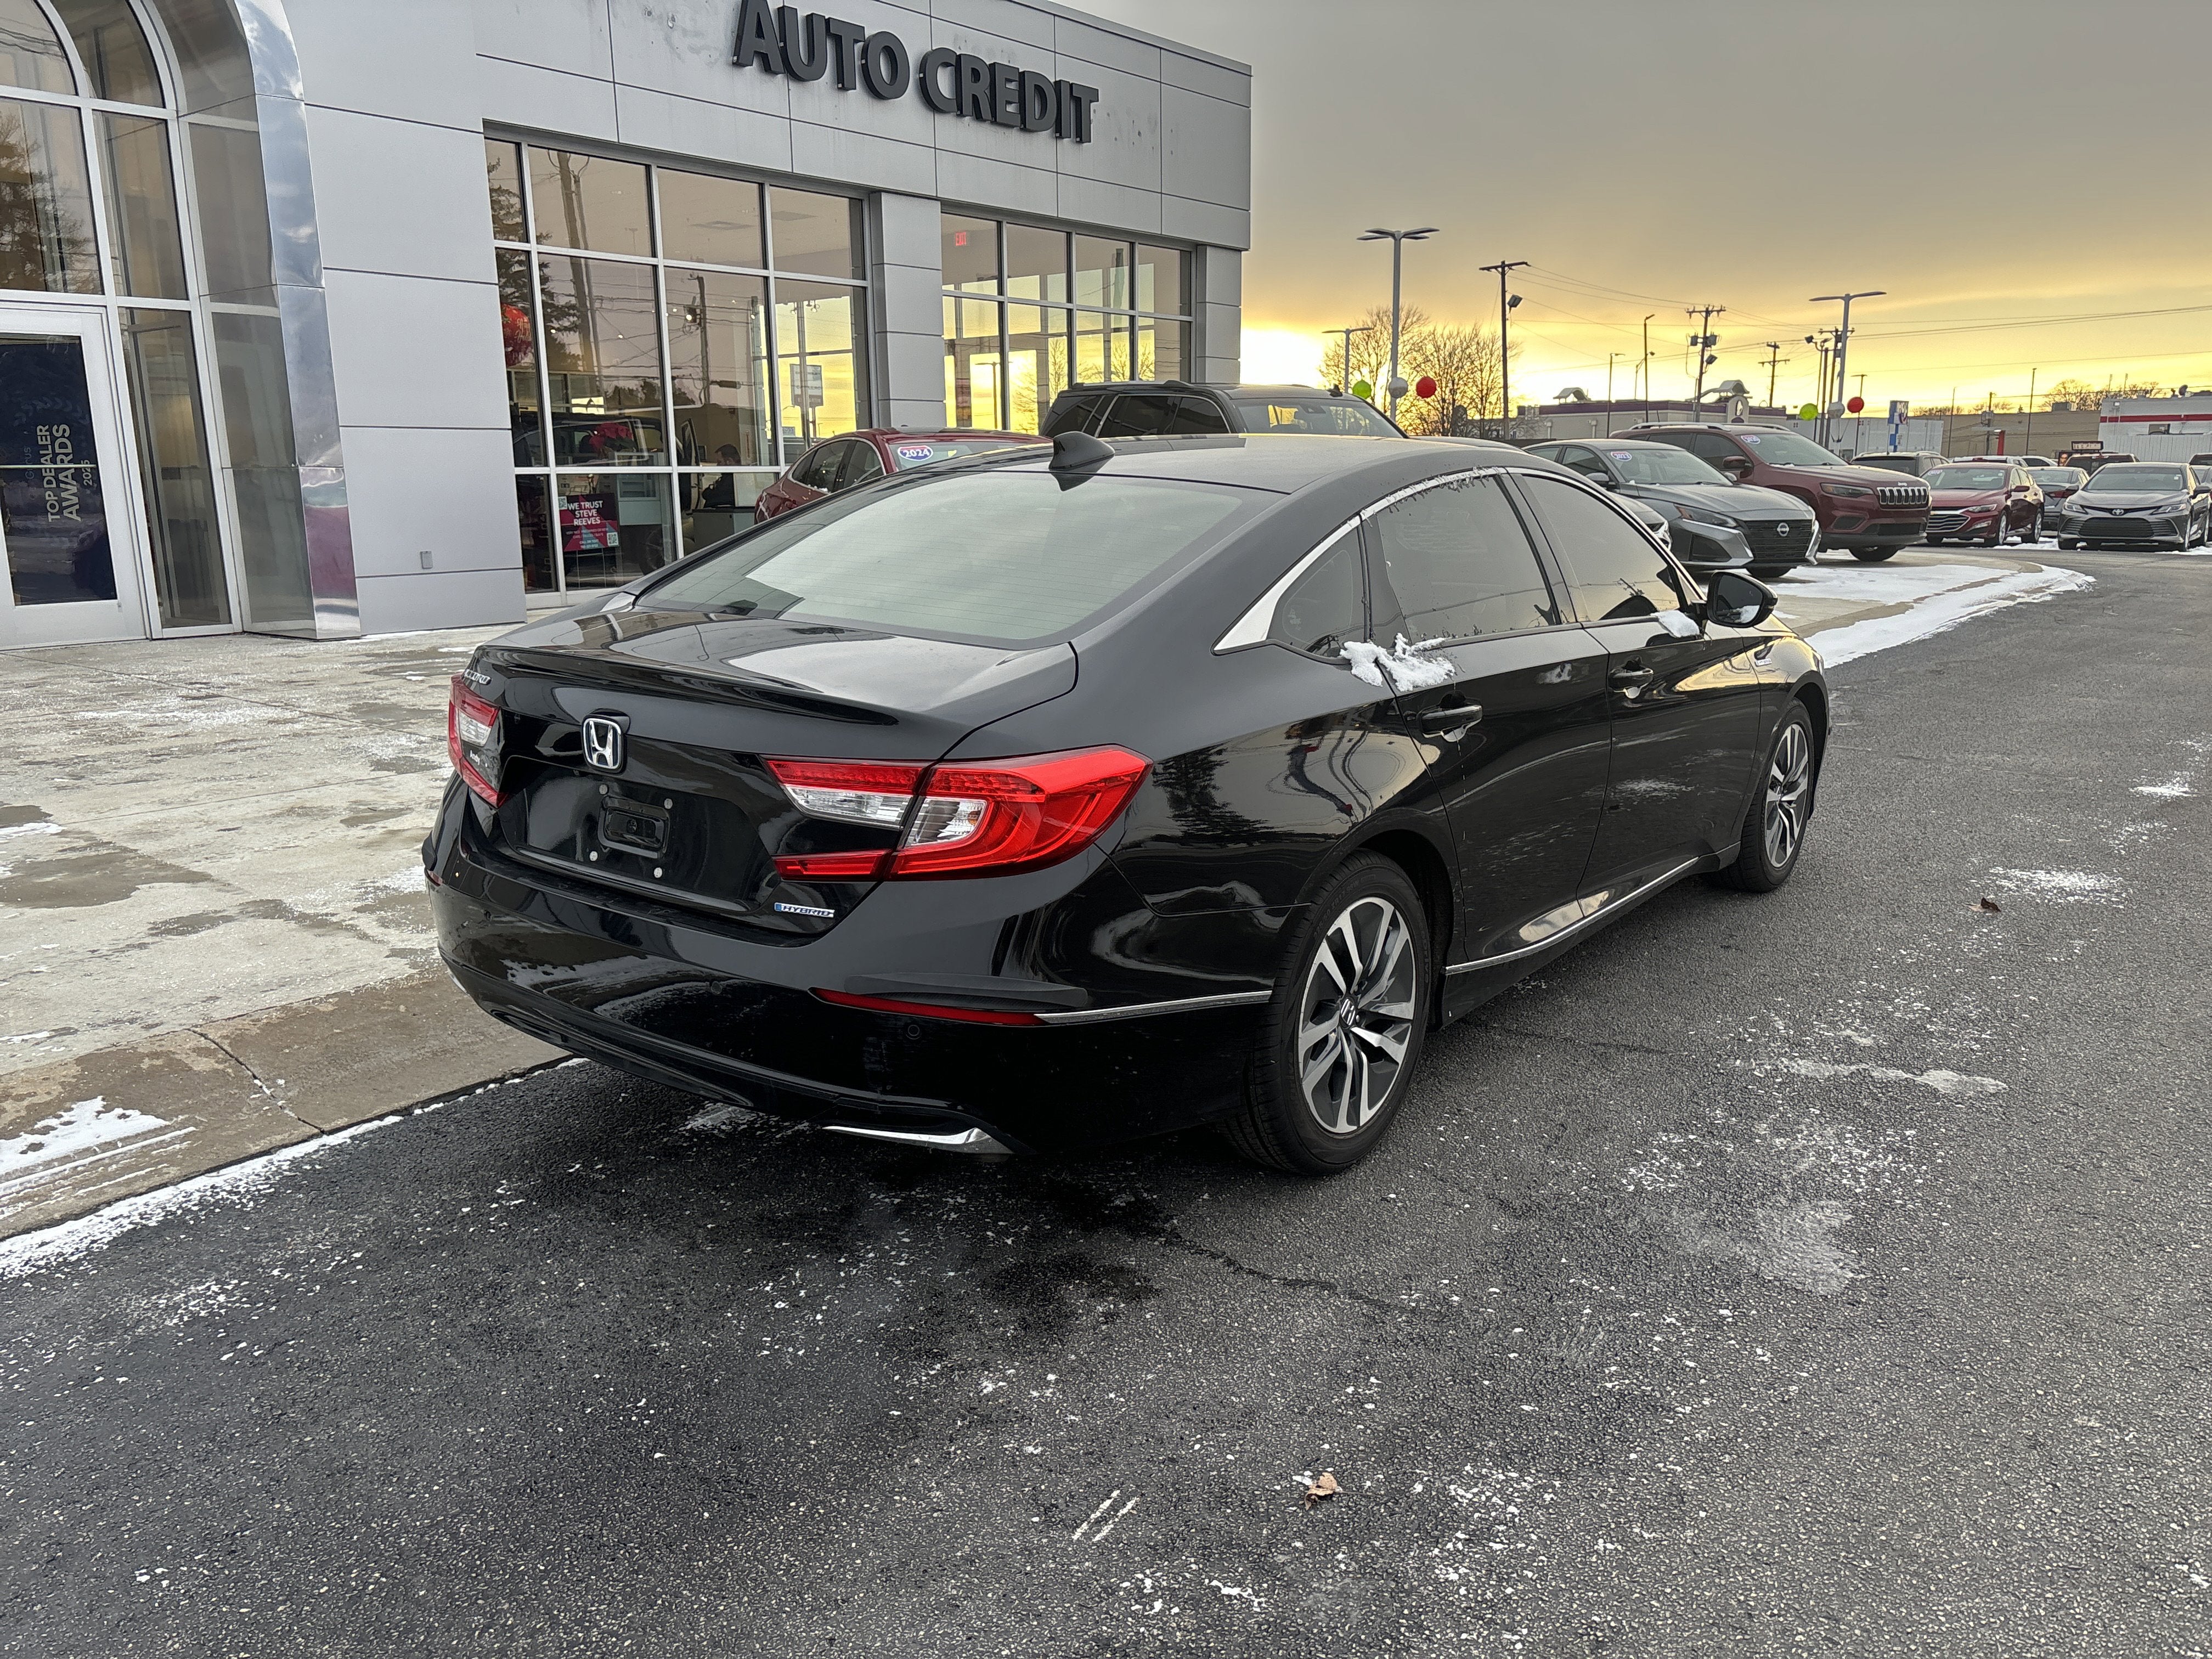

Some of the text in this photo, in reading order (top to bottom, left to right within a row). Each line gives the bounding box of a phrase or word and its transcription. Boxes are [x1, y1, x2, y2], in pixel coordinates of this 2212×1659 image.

[732, 0, 1099, 143] AUTO CREDIT
[902, 448, 930, 458] 2024
[36, 424, 61, 522] TOP DEALER
[52, 424, 82, 522] AWARDS
[567, 500, 603, 511] WE TRUST
[575, 509, 597, 518] STEVE
[573, 516, 601, 526] REEVES
[782, 905, 831, 917] HYBRID
